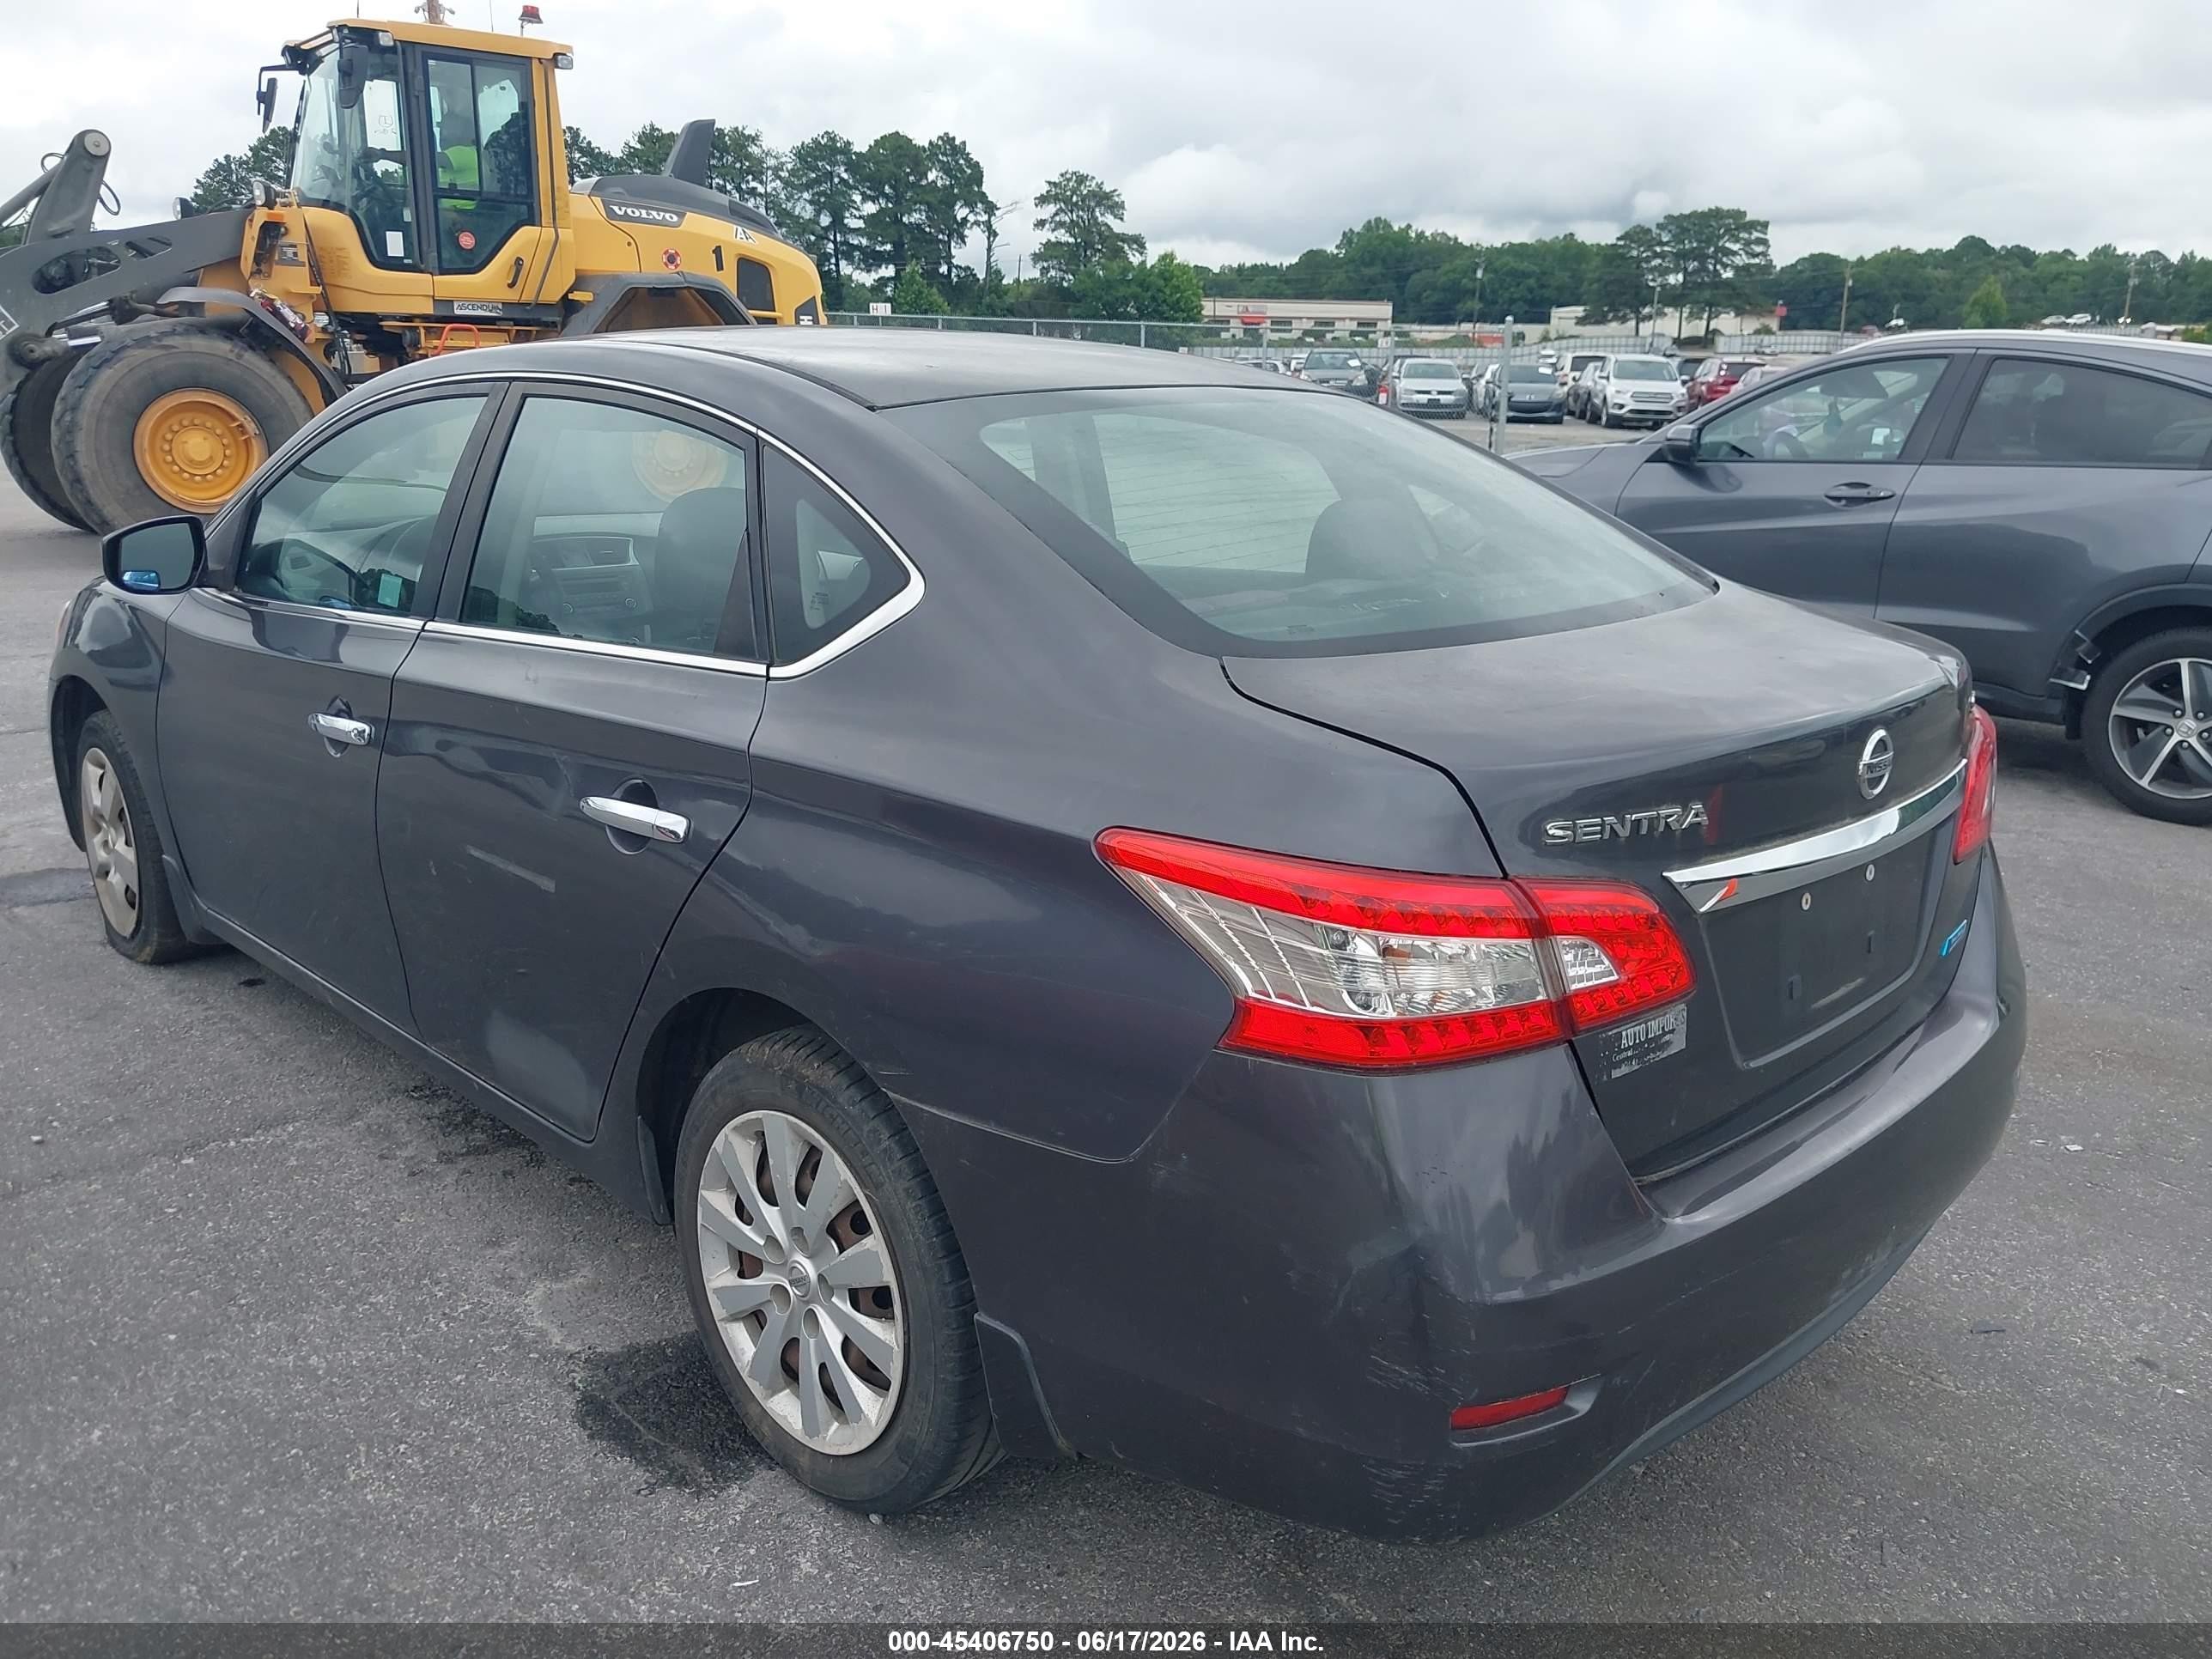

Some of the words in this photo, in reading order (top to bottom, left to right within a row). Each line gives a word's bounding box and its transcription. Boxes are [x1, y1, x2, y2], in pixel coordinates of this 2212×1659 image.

[609, 205, 678, 222] VOLVO
[711, 245, 725, 271] 1
[1866, 757, 1892, 775] NISS
[1545, 803, 1709, 845] SENTRA
[1621, 1024, 1646, 1049] AUTO
